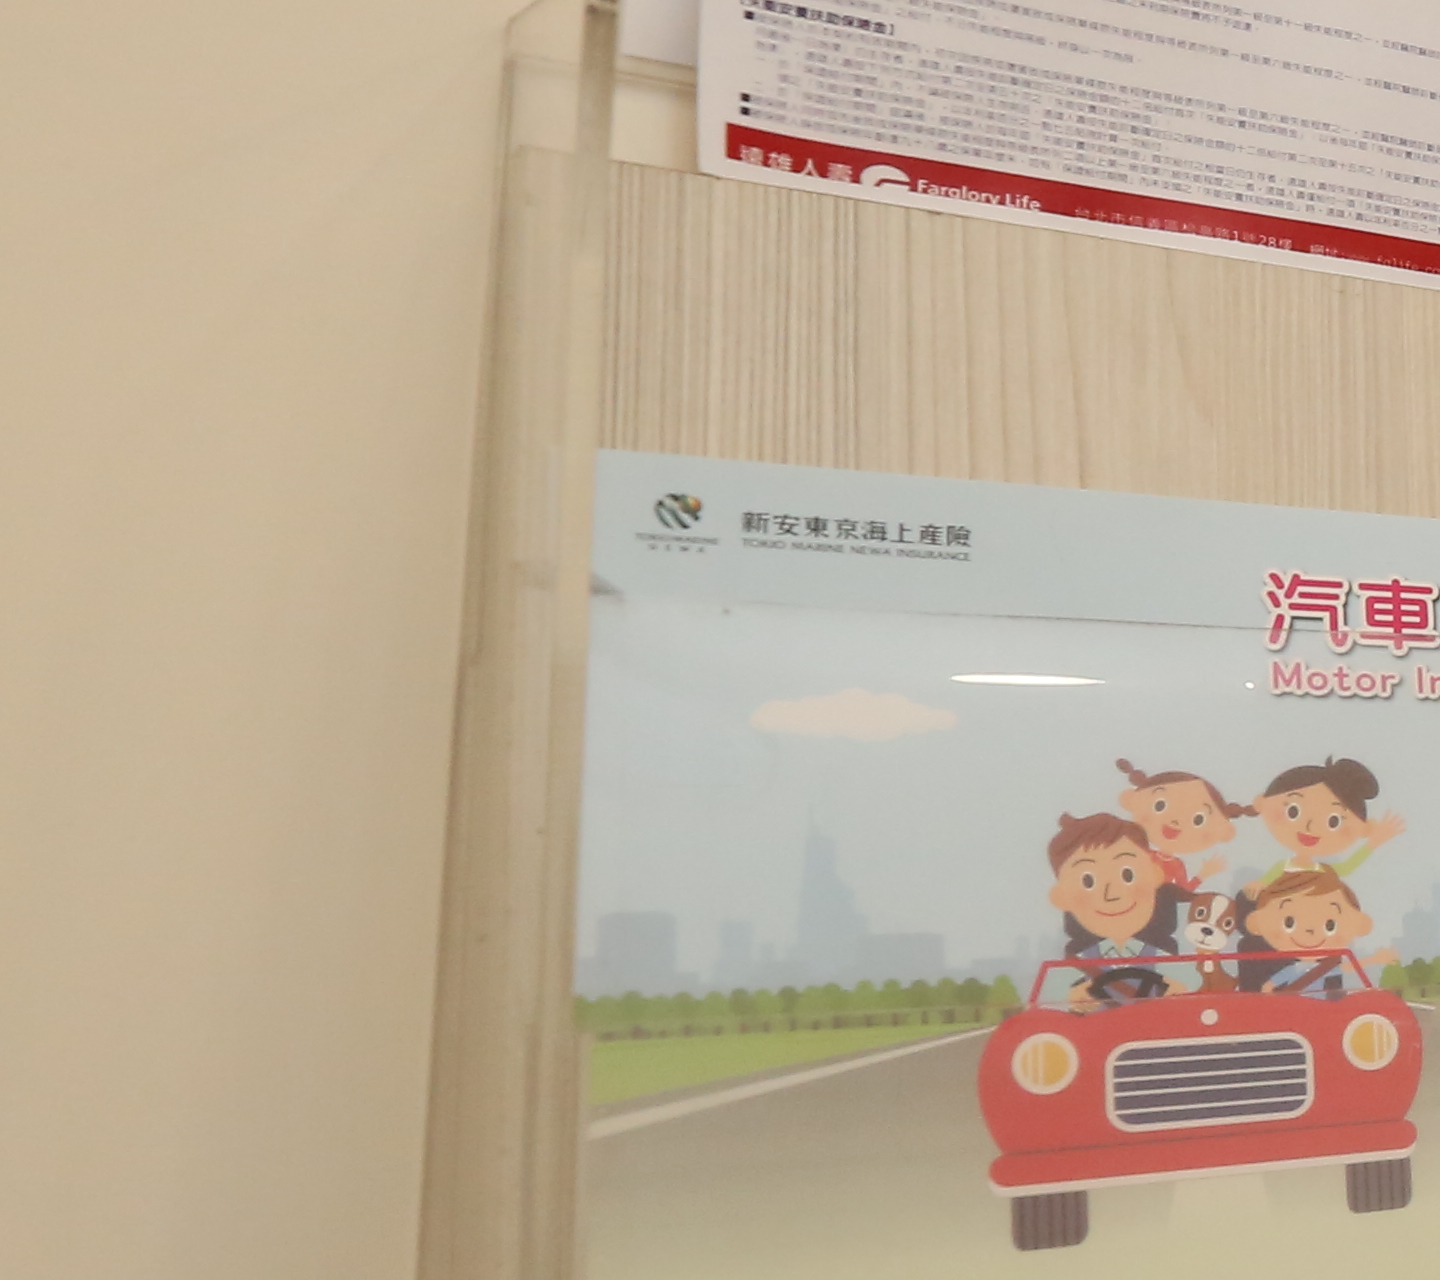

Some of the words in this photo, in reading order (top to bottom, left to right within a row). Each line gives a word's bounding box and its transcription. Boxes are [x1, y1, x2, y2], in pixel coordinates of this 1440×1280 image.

[738, 145, 854, 184] 遠雄人壽
[916, 177, 1002, 208] Farglory
[1003, 187, 1043, 214] Life
[740, 510, 973, 549] 新安東京海上產險
[1268, 660, 1398, 699] Motor
